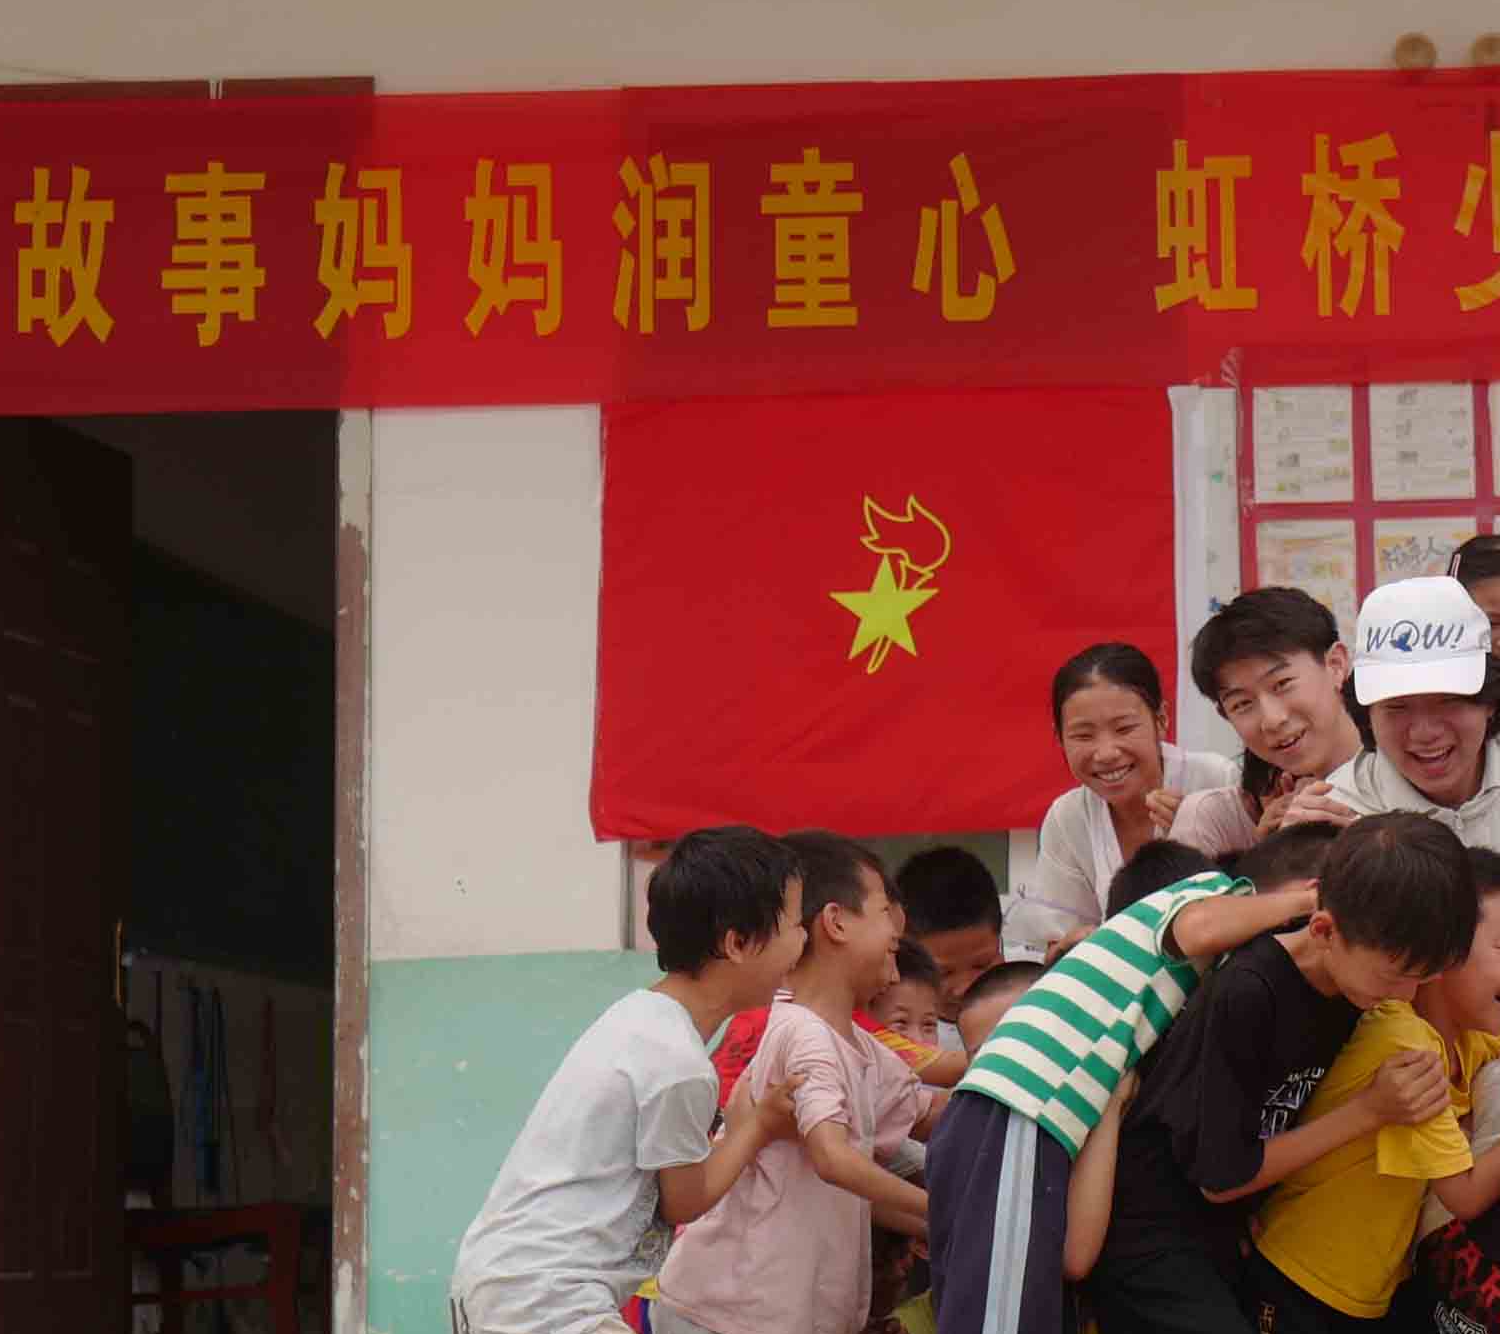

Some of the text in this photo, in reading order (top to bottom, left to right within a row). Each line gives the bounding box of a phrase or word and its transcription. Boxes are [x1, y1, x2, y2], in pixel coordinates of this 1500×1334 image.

[13, 146, 1016, 347] 故事妈妈润童心
